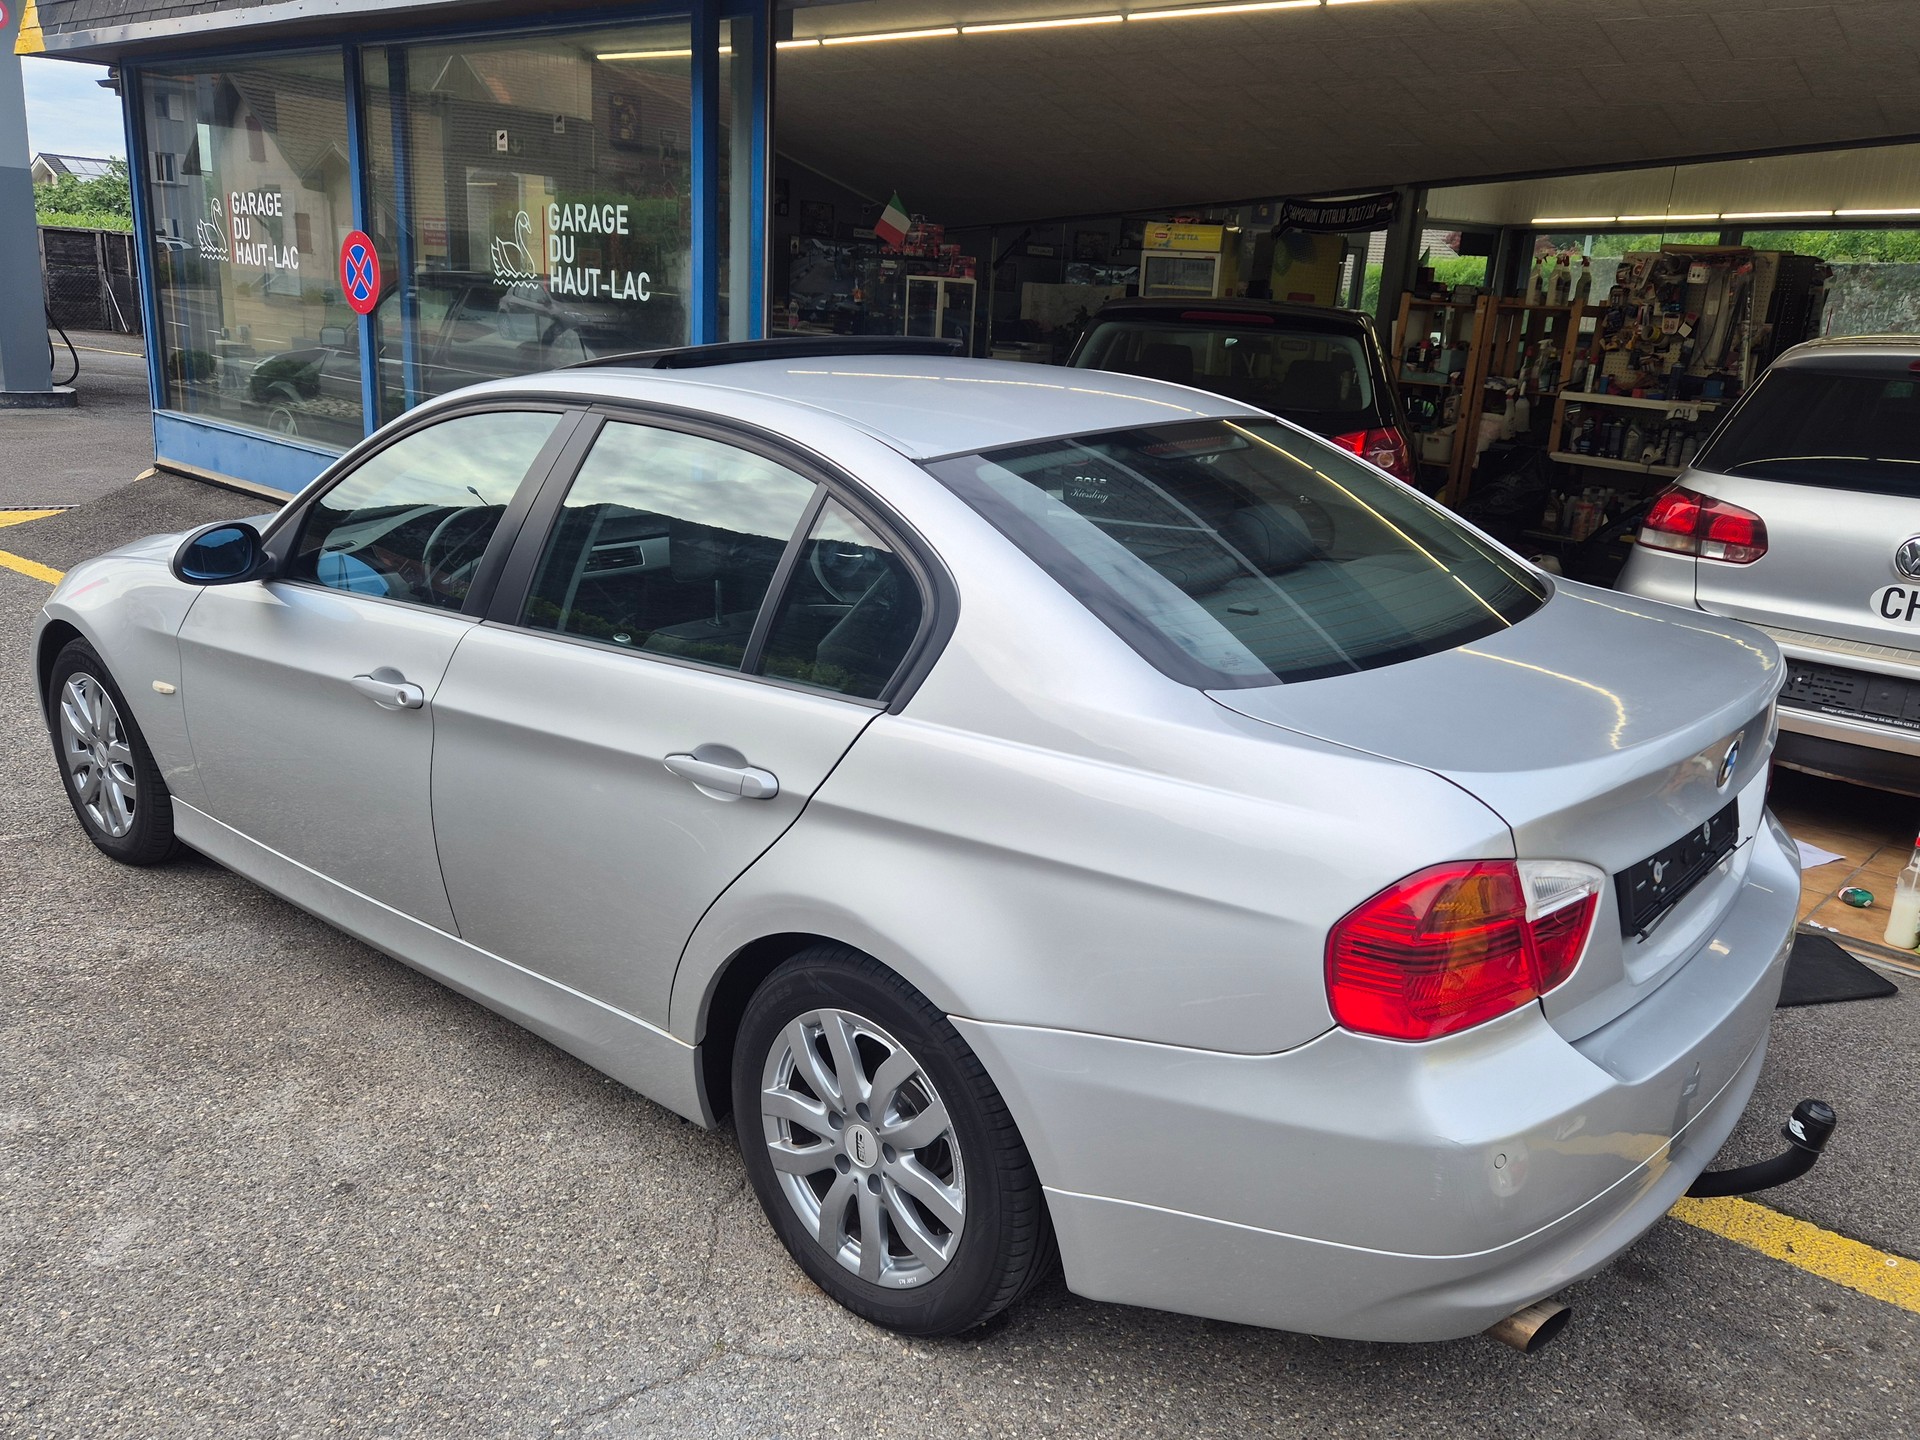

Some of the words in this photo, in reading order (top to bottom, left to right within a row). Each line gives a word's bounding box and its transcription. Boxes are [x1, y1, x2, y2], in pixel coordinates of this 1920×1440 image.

[231, 191, 283, 216] GARAGE
[1288, 204, 1320, 224] CAMPIONI
[1320, 207, 1347, 224] D'ITALIA
[233, 216, 250, 240] DU
[548, 202, 629, 235] GARAGE
[549, 234, 575, 264] DU
[1174, 232, 1186, 241] ICE
[1187, 233, 1199, 241] TEA
[235, 242, 299, 269] HAUT-LAC
[550, 266, 651, 302] HAUT-LAC
